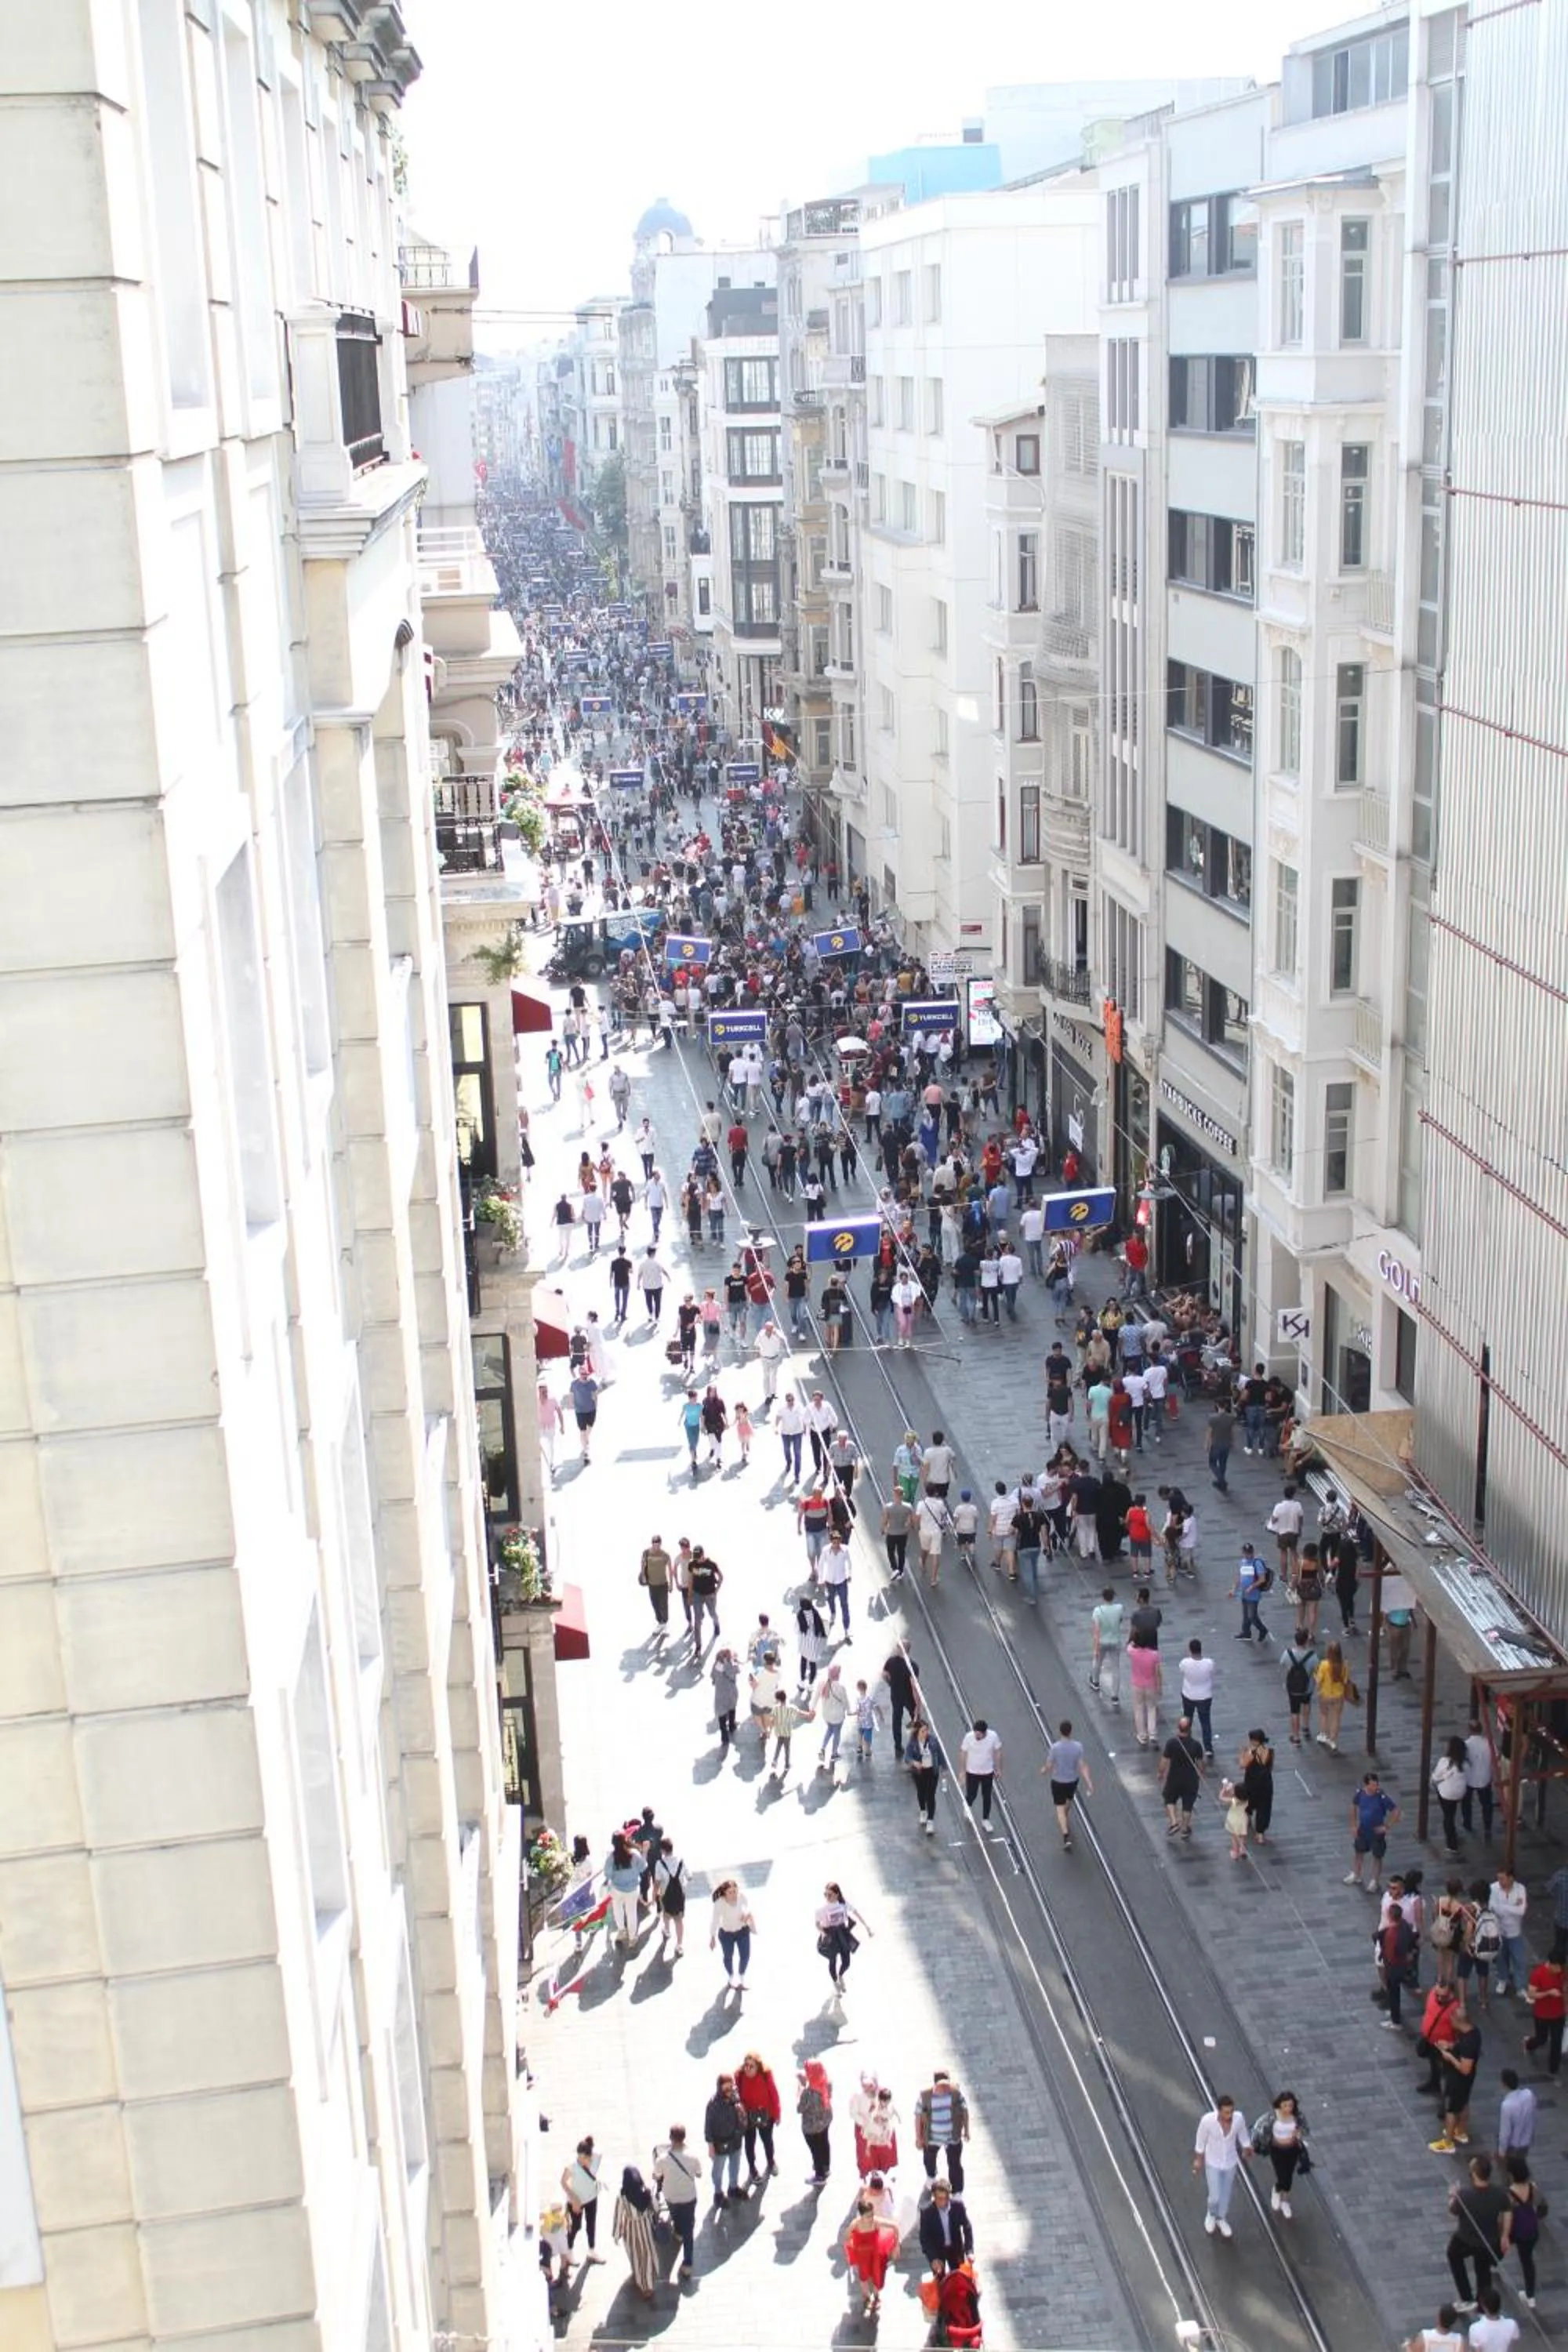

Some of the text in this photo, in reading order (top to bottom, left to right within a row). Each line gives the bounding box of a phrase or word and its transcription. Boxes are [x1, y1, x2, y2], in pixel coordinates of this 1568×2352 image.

[920, 1013, 954, 1022] TURKCELL
[726, 1024, 762, 1033] TURKCELL
[1160, 1079, 1233, 1155] STARBUCKS COFFEE
